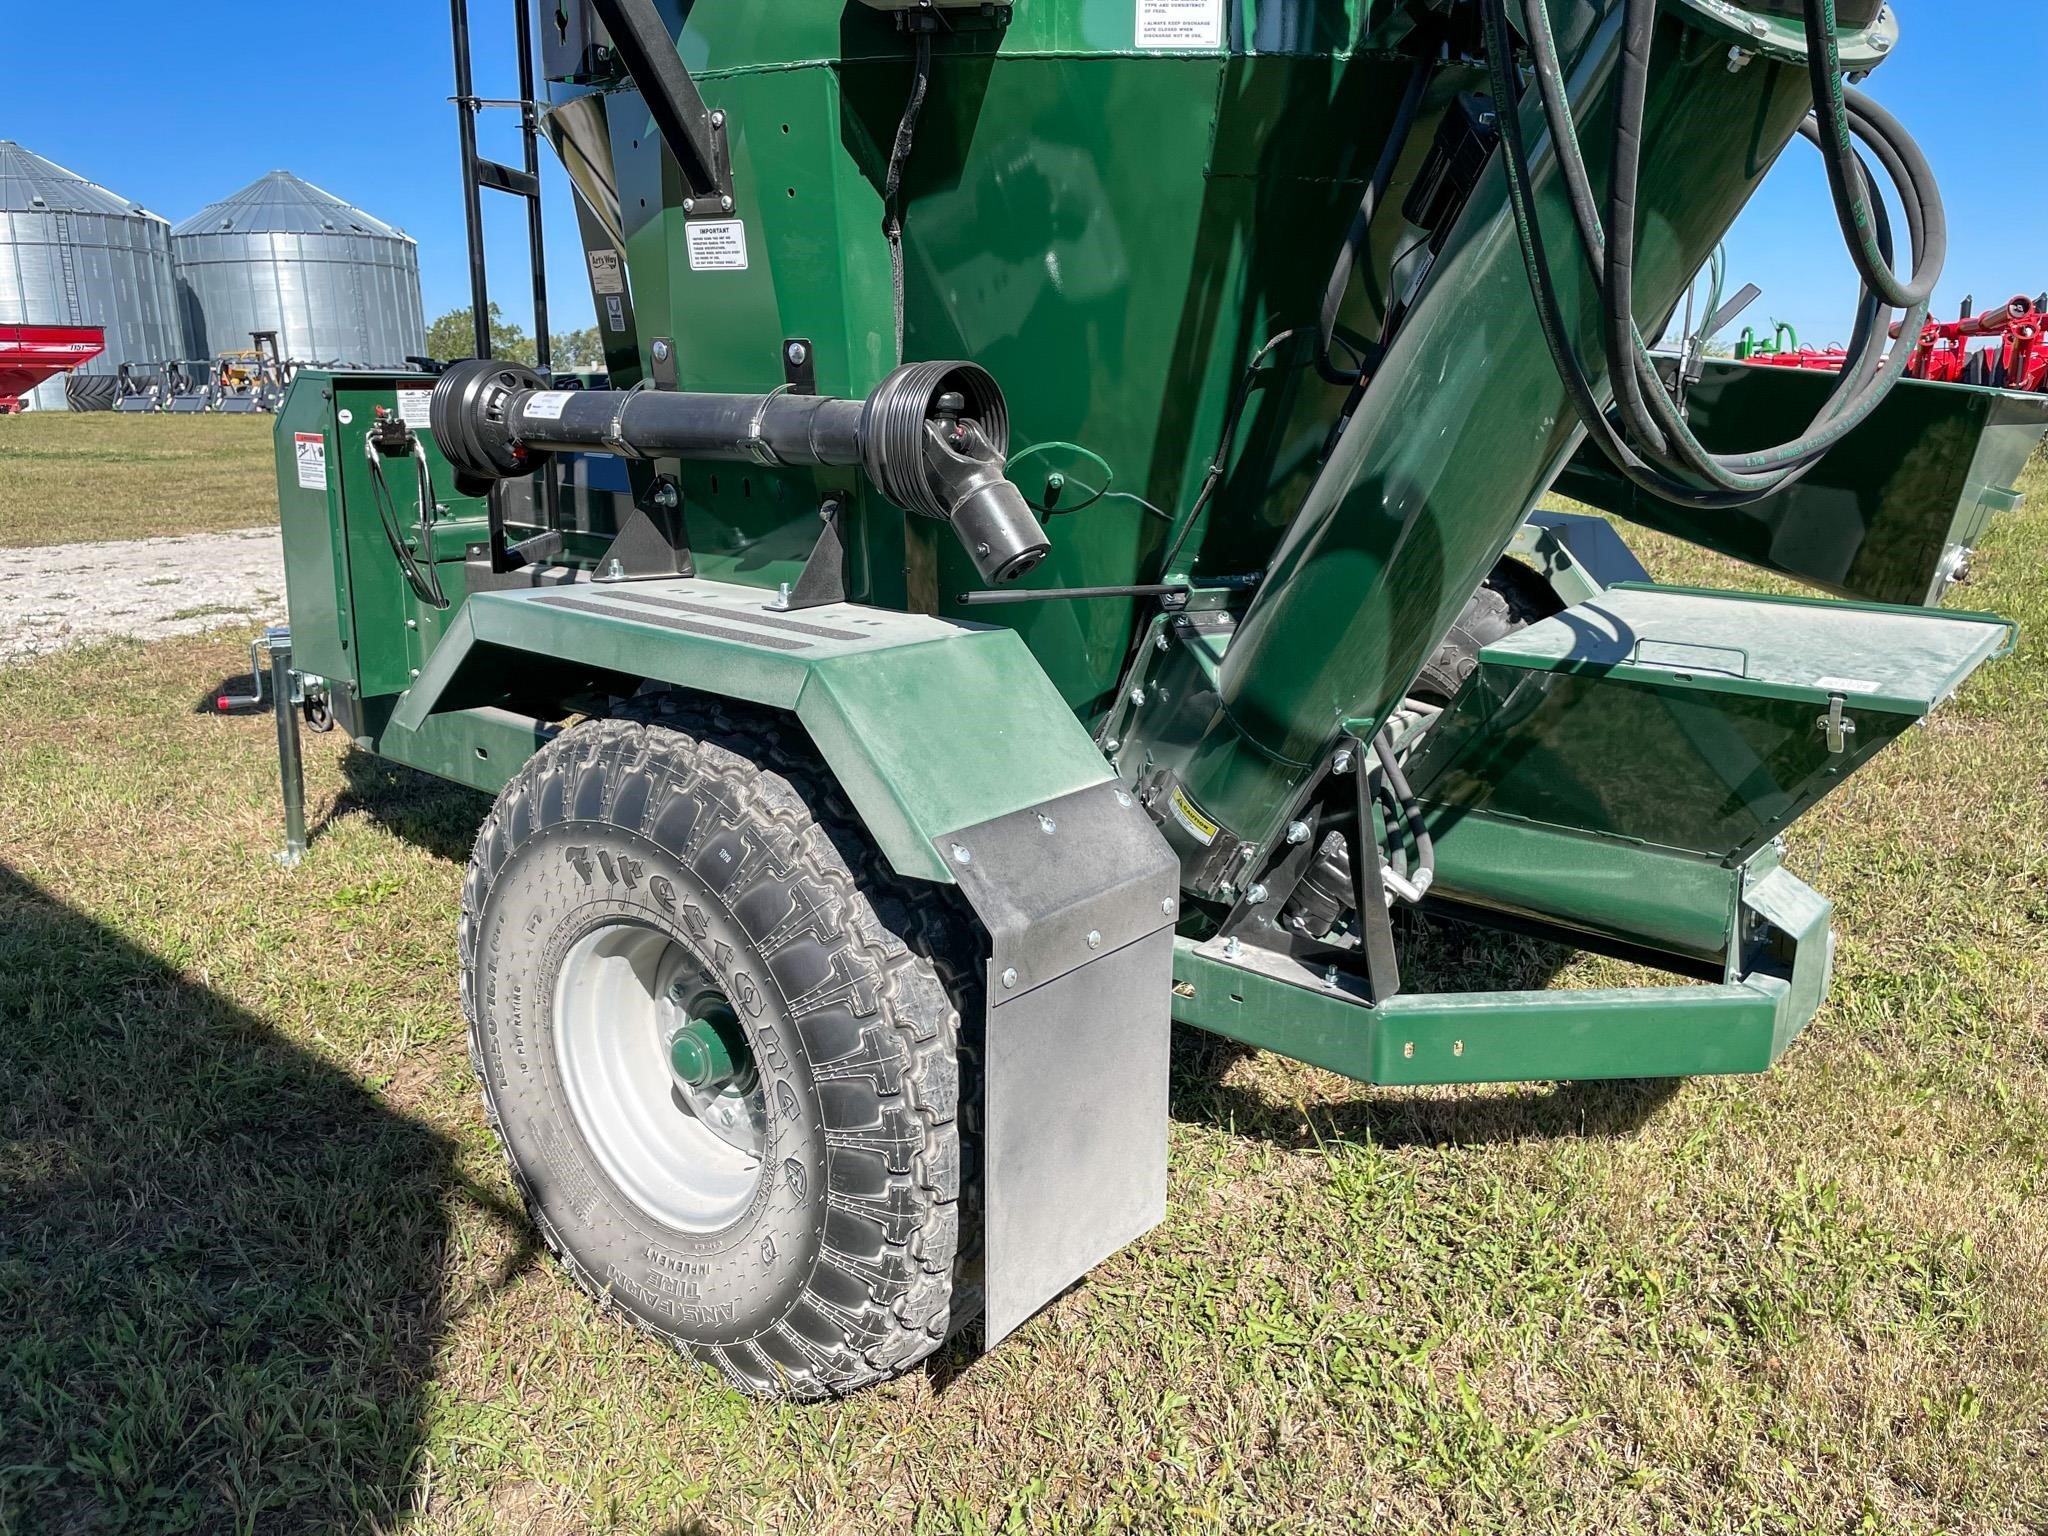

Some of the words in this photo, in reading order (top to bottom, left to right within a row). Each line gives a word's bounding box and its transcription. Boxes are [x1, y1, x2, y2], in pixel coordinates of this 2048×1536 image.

[699, 227, 730, 235] IMPORTANT
[1183, 805, 1209, 830] CAUTION
[565, 845, 801, 1122] Firestone
[512, 984, 522, 1027] RATING
[516, 1034, 525, 1054] PLY
[643, 1247, 711, 1275] IMPLEMENT
[607, 1263, 675, 1317] FARM
[646, 1268, 701, 1300] TIRE
